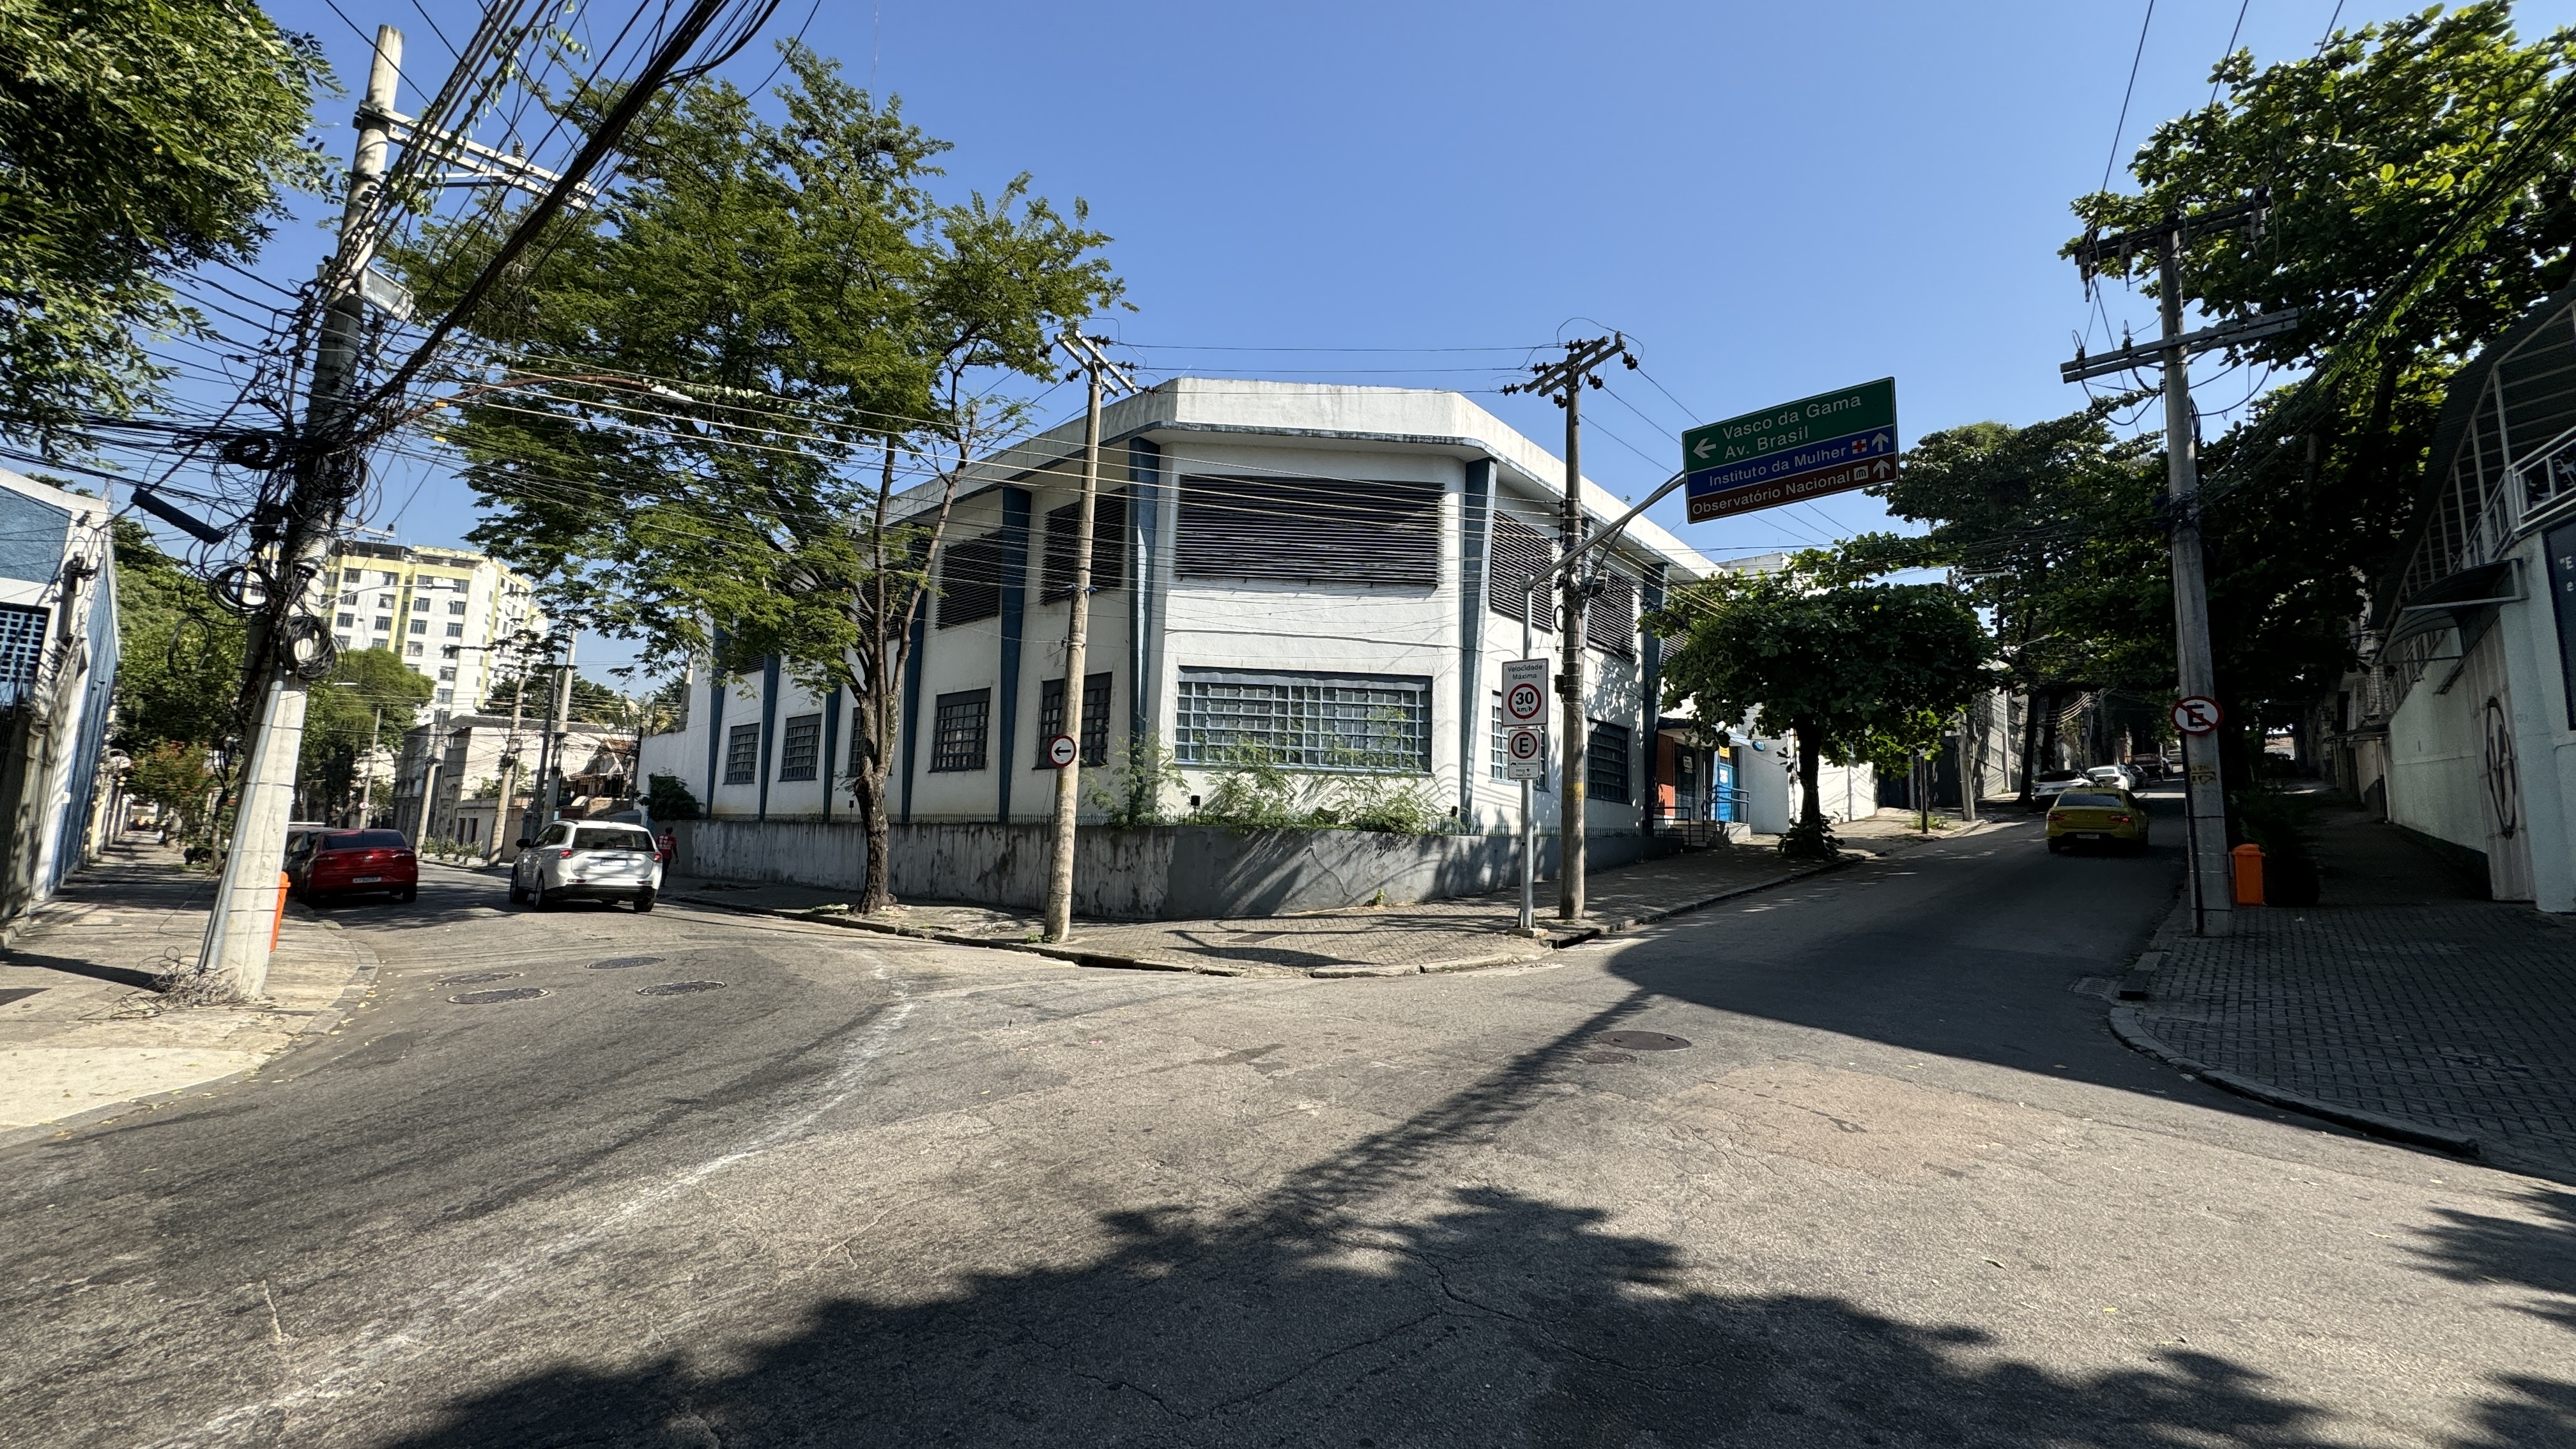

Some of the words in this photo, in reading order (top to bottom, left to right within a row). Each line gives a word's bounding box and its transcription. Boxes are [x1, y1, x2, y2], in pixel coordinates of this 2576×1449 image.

[1722, 418, 1772, 440] Vasco
[1777, 411, 1800, 426] da
[1805, 395, 1862, 418] Gama
[1724, 445, 1750, 459] Av.
[1758, 425, 1809, 452] Brasil
[1709, 466, 1767, 487] Instituto
[1771, 460, 1790, 473] da
[1794, 446, 1847, 468] Mulher
[1692, 486, 1781, 515] Observatório
[1786, 470, 1850, 494] Nacional
[1507, 664, 1543, 673] Velocidade
[1515, 691, 1535, 705] 30
[2186, 704, 2207, 726] E
[1519, 737, 1529, 753] E
